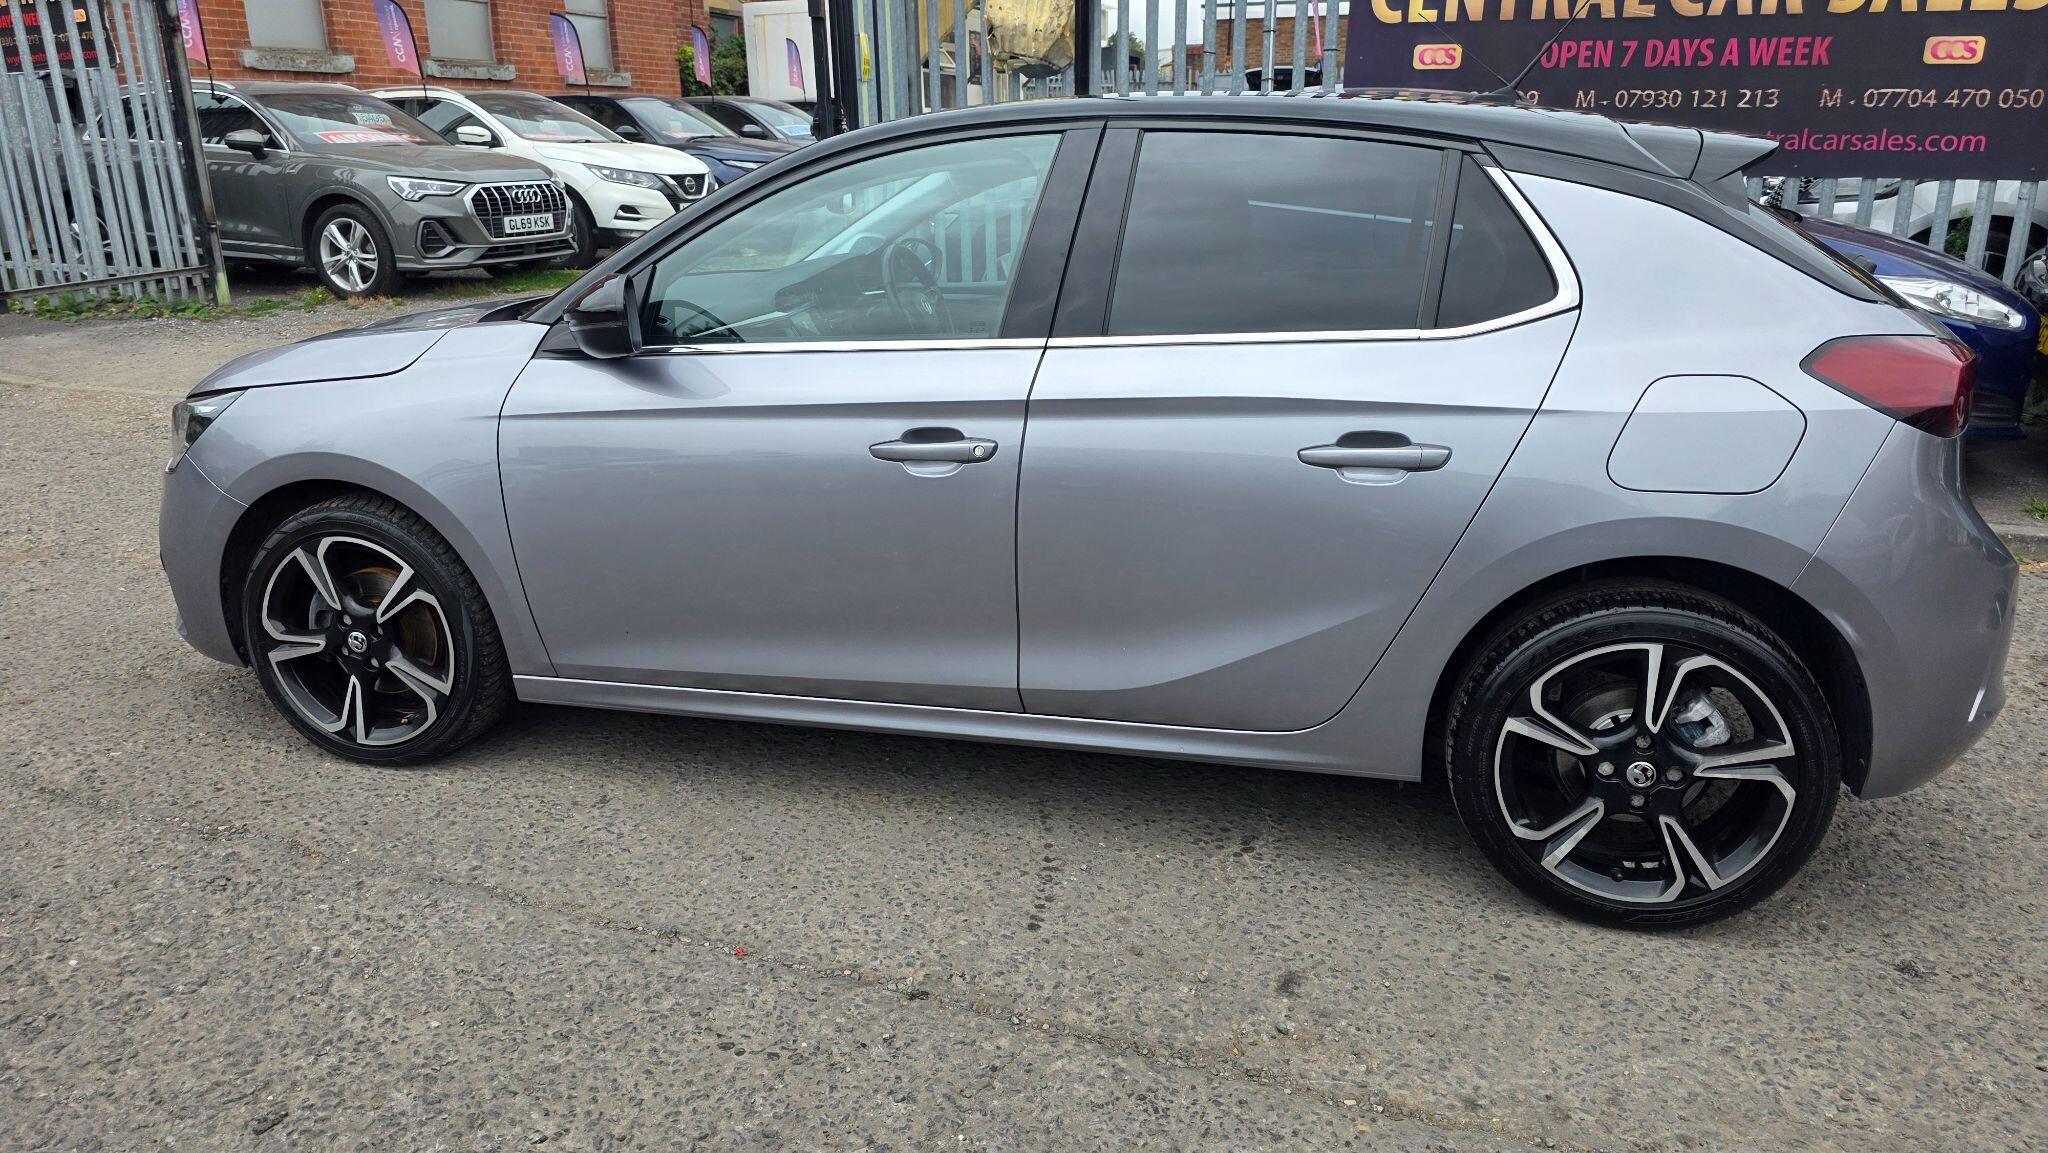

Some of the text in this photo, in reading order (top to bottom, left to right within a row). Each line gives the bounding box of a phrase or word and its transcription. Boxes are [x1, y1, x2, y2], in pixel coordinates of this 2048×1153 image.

[392, 33, 406, 63] CCM
[563, 47, 574, 72] CCM
[1540, 36, 1834, 69] OPEN 7 DAYS A WEEK
[1575, 89, 1596, 109] M
[1614, 89, 1682, 109] 07930
[1691, 89, 1729, 108] 121
[1737, 88, 1781, 108] 213
[1819, 88, 1843, 108] M
[1863, 88, 1938, 108] 07704
[1943, 88, 1991, 108] 470
[1998, 88, 2045, 108] 050
[509, 216, 550, 230] GL69 KSK
